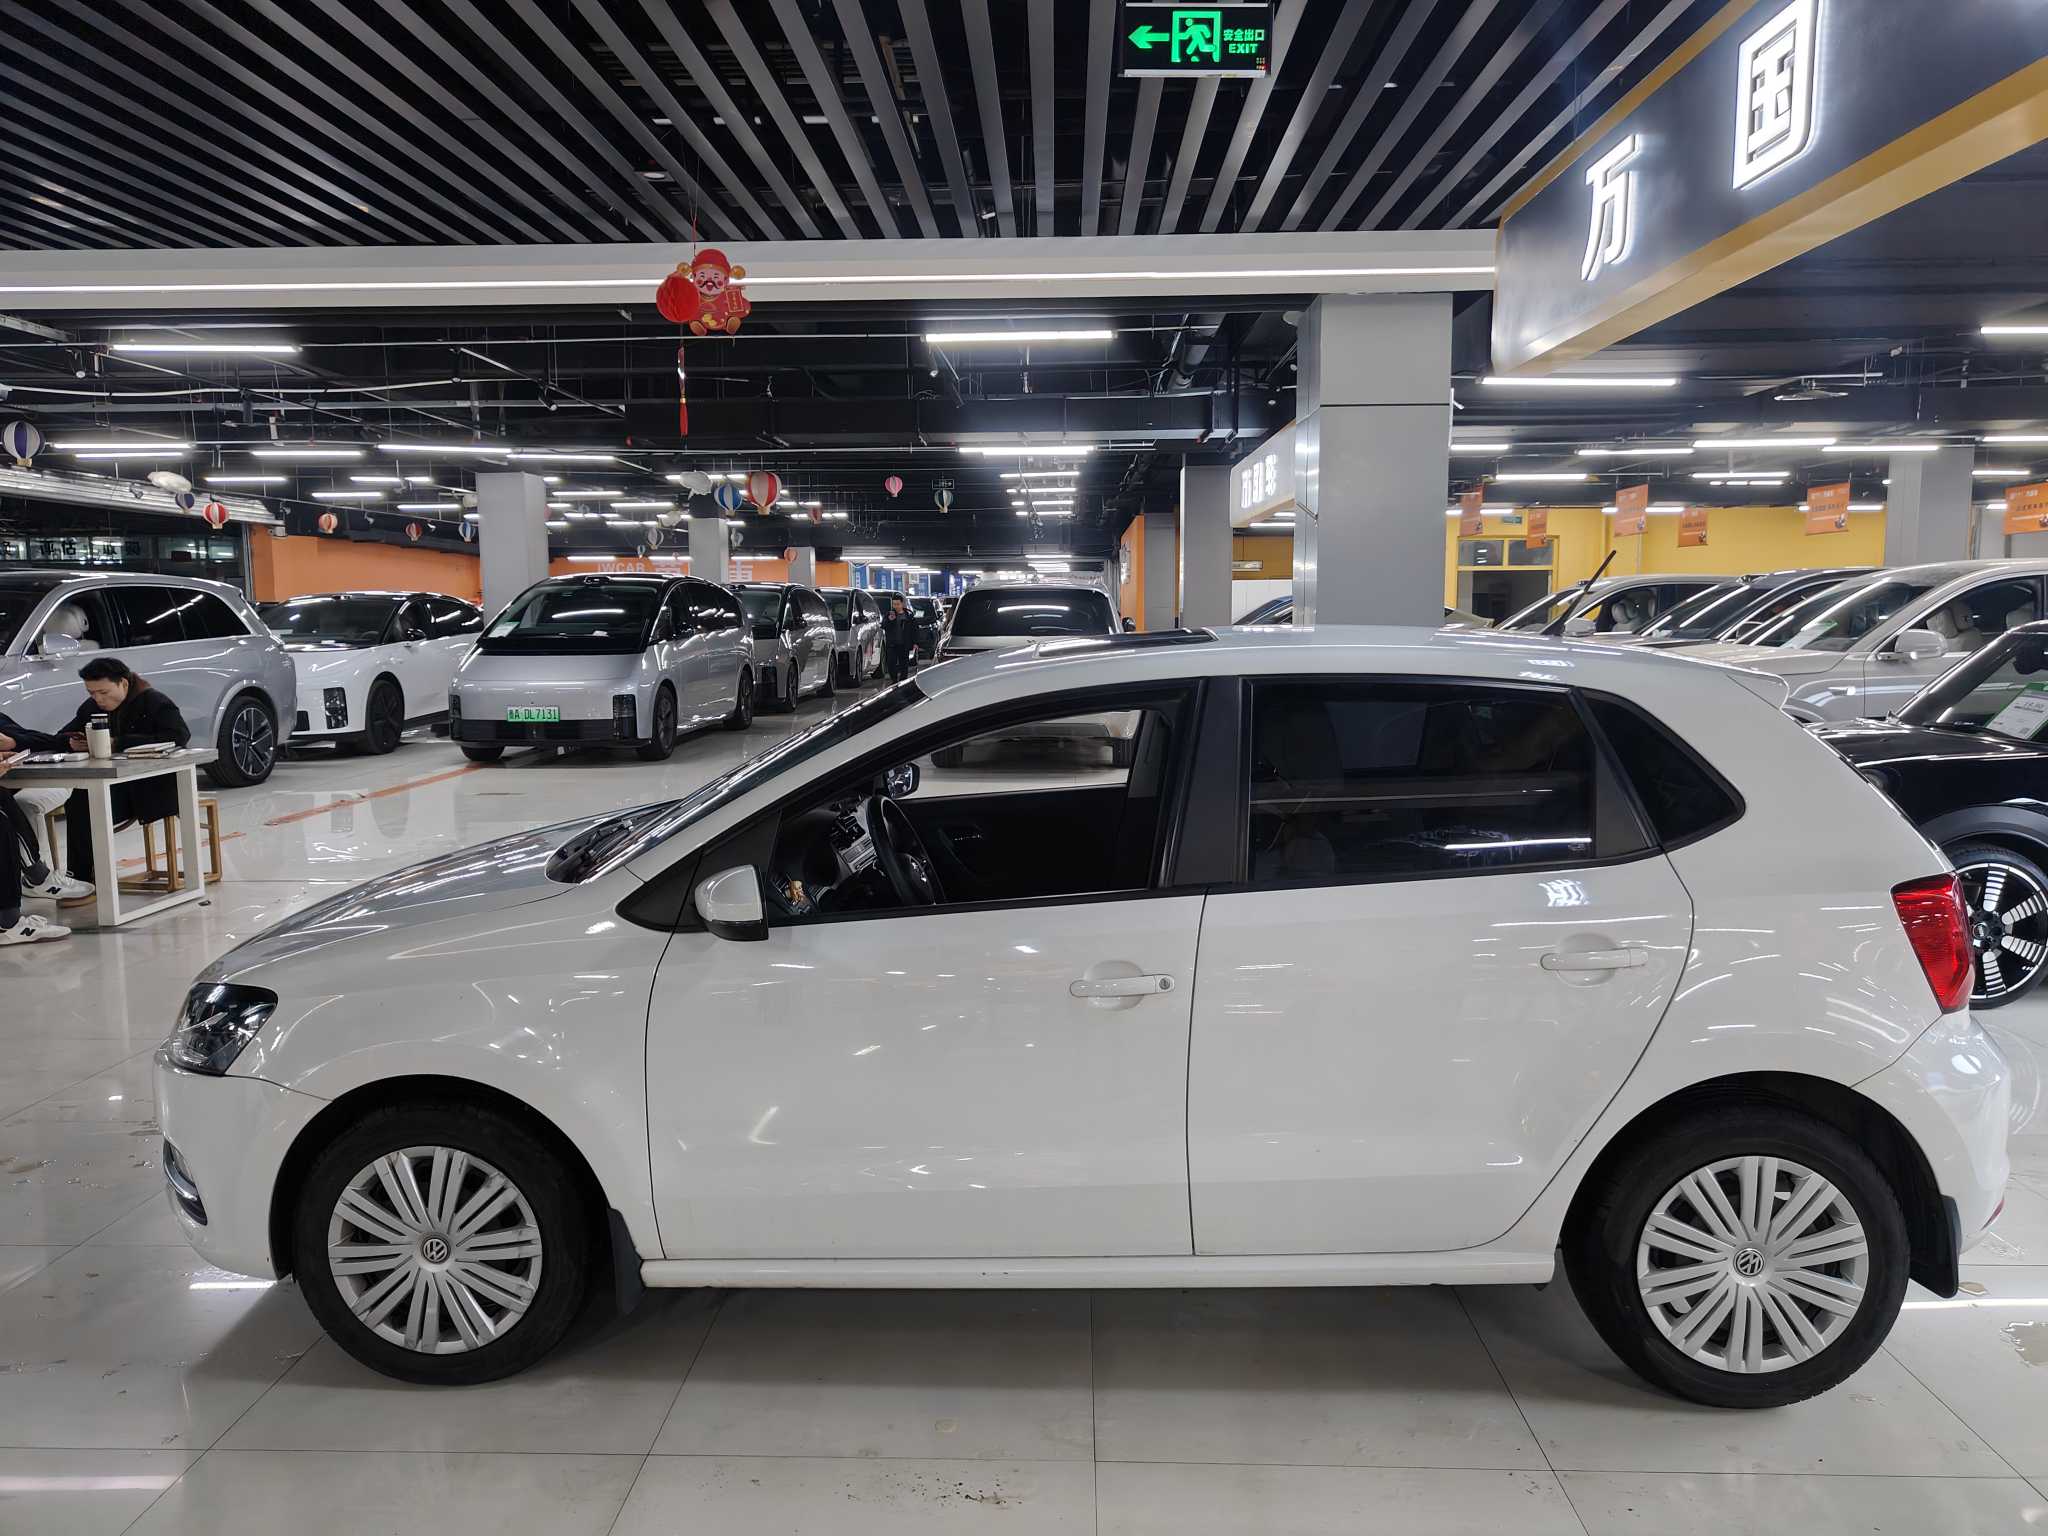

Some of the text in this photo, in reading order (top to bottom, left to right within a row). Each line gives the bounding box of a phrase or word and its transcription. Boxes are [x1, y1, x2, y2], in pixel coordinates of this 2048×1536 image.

[1223, 29, 1265, 41] 安全出口
[1228, 44, 1258, 53] EXIT
[1581, 0, 1821, 281] 万国
